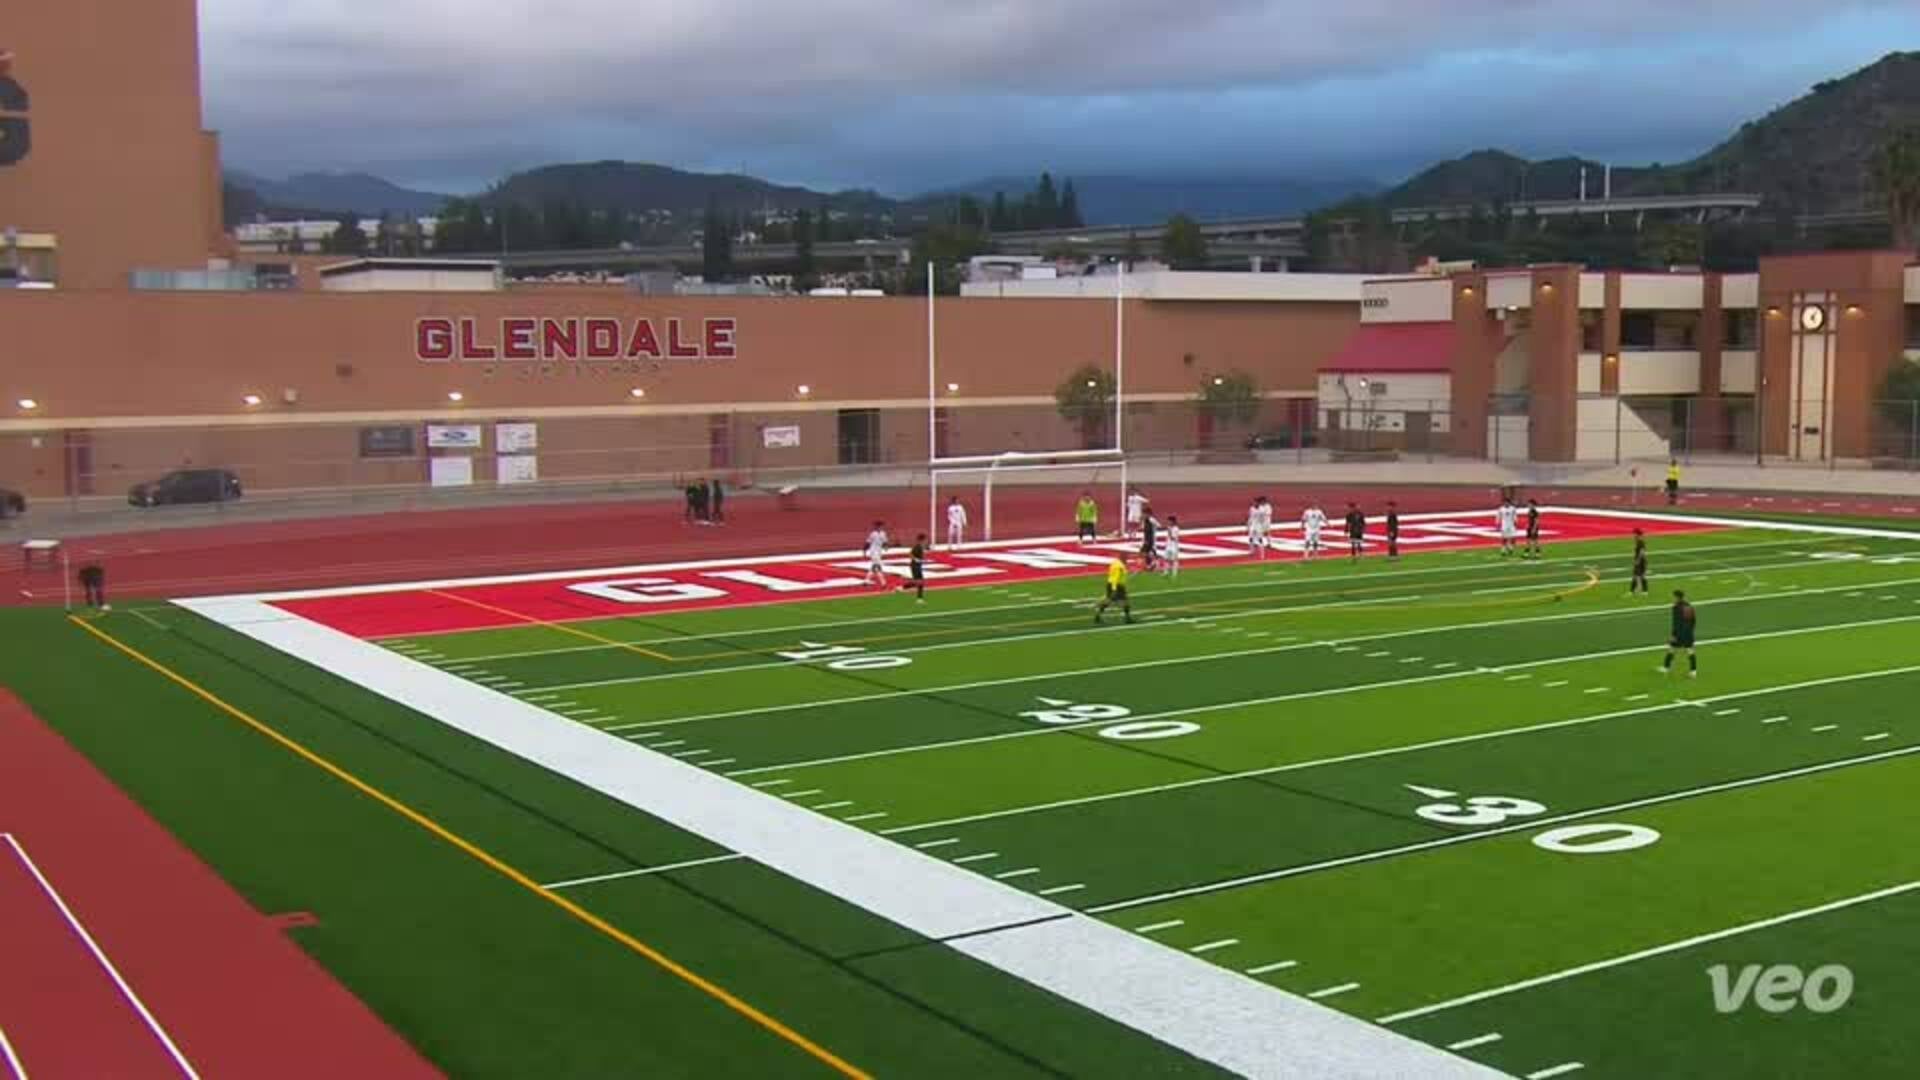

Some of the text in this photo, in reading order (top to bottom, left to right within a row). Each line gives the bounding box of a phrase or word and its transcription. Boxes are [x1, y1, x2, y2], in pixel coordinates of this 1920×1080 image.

[416, 316, 738, 361] GLENDALE
[1019, 700, 1202, 740] 20
[1415, 796, 1661, 853] 30
